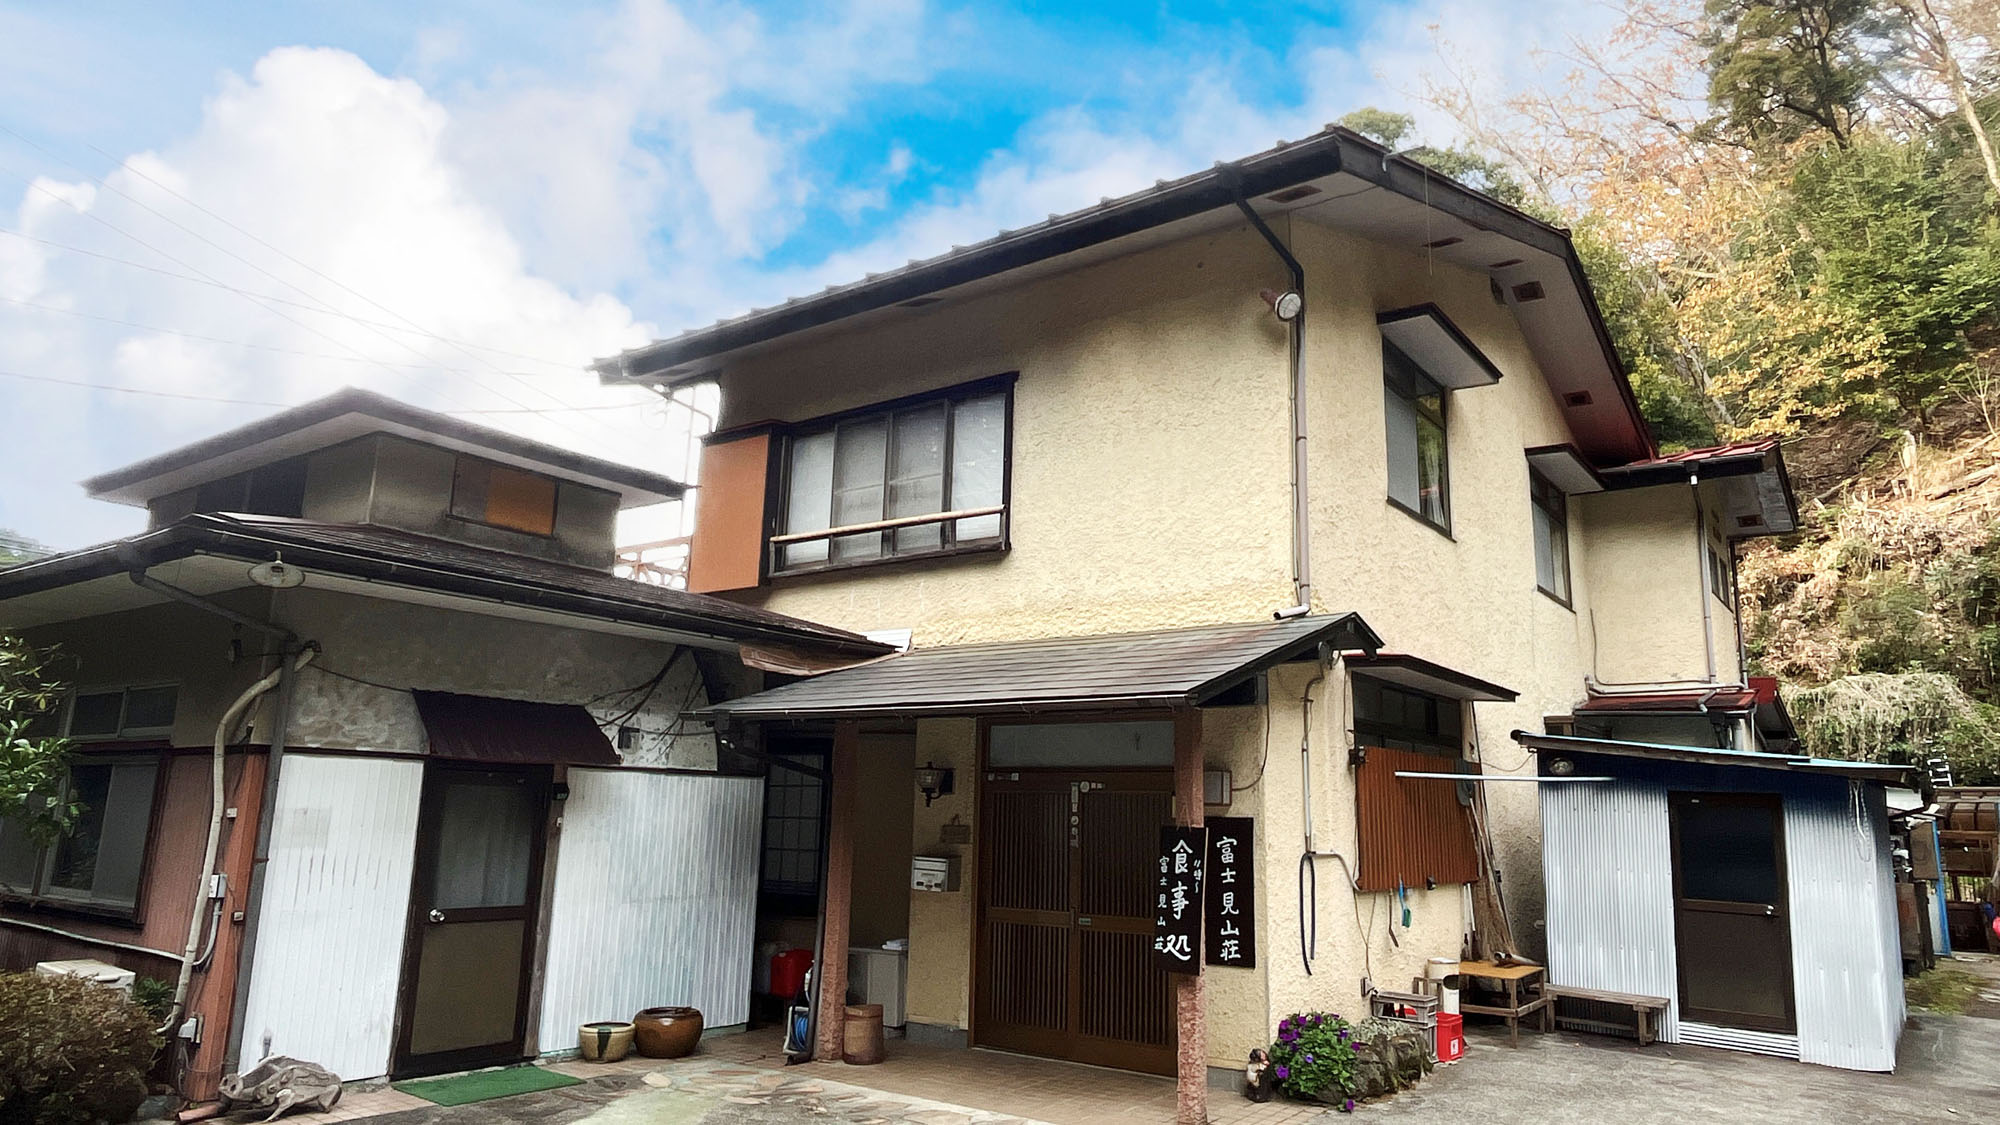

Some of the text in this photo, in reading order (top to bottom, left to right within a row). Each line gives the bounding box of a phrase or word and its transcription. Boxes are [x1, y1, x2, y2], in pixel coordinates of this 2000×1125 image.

[1154, 855, 1170, 950] 富士見山荘
[1162, 839, 1194, 961] 食事処
[1216, 836, 1242, 961] 富士見山荘
